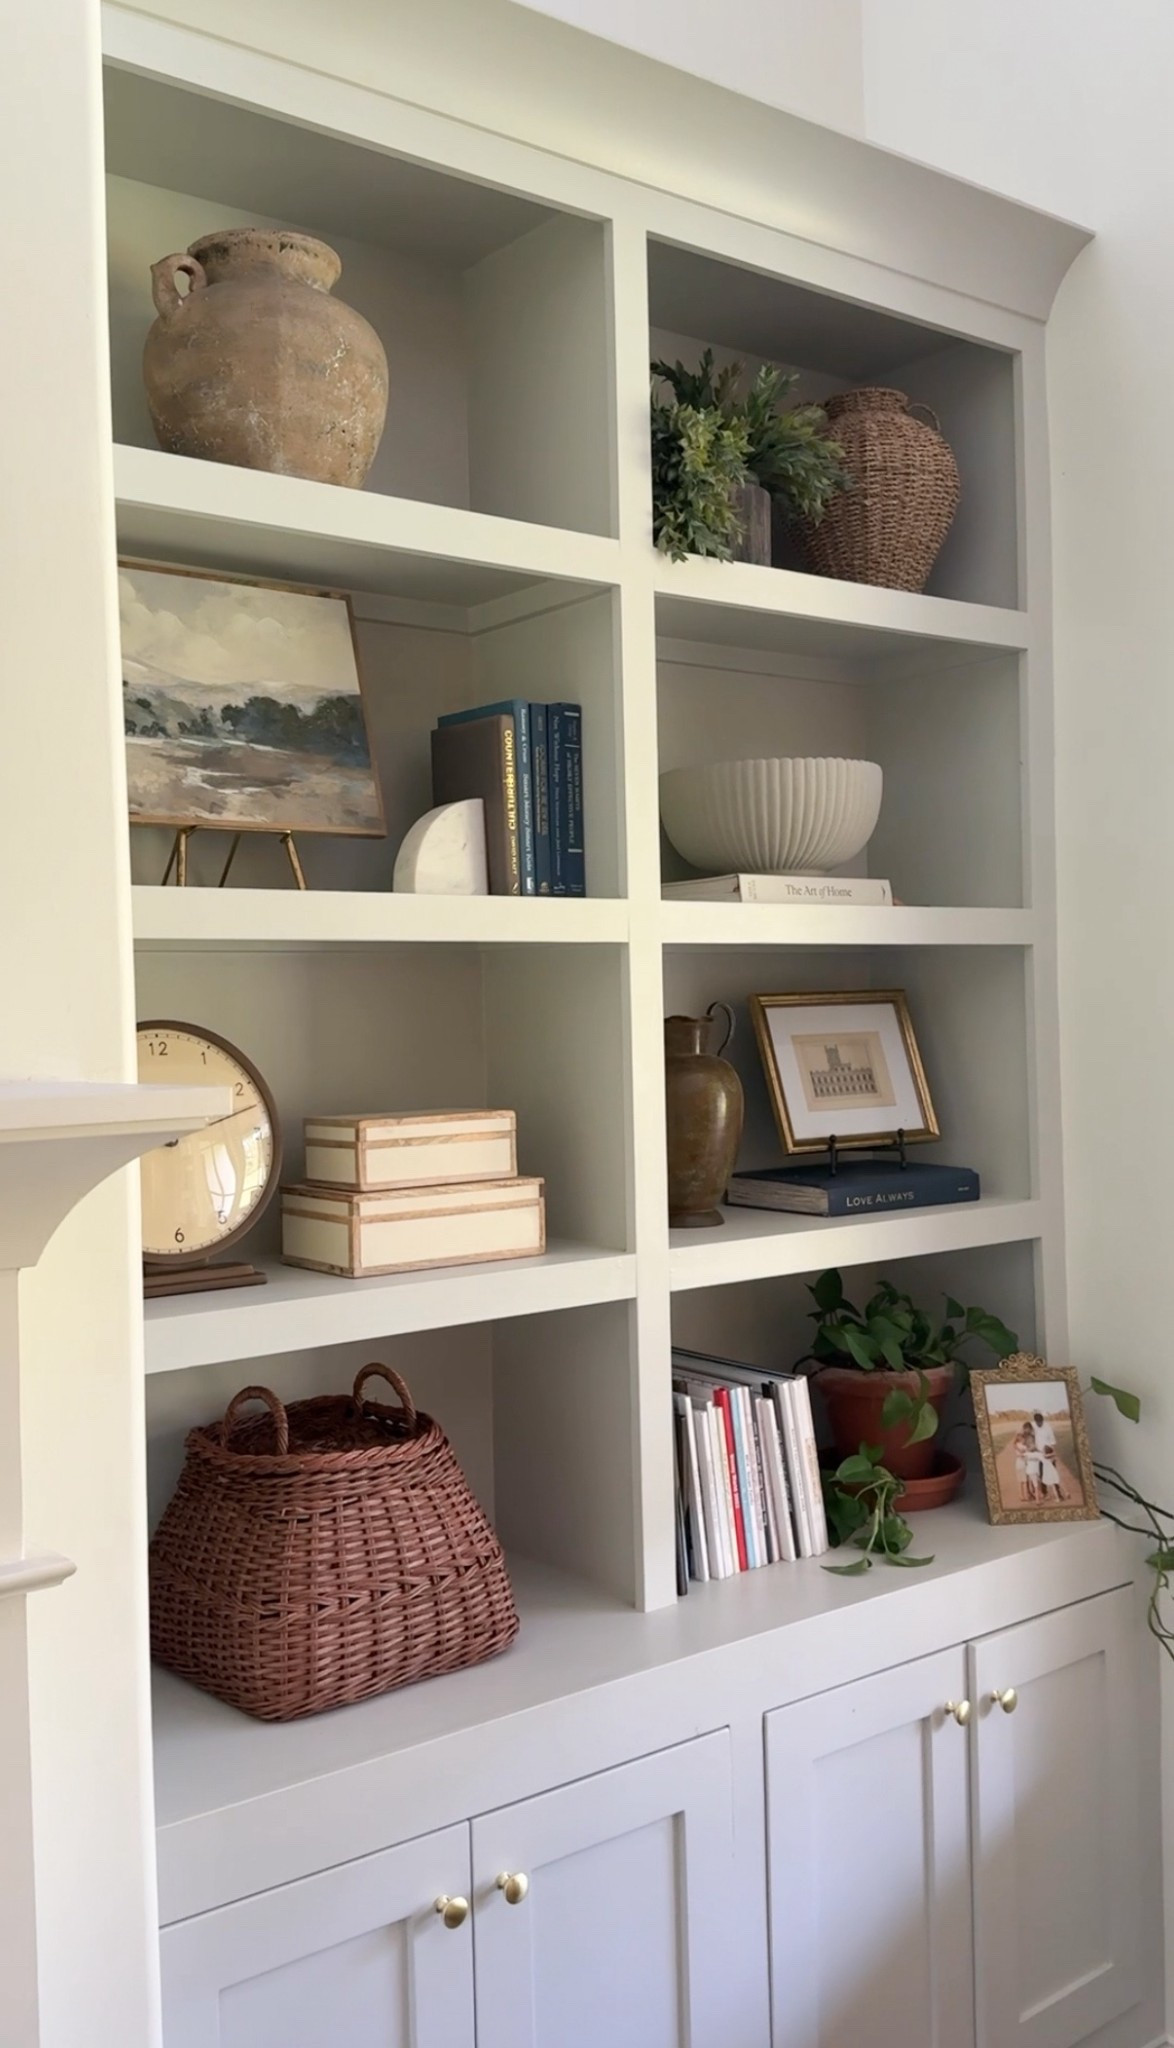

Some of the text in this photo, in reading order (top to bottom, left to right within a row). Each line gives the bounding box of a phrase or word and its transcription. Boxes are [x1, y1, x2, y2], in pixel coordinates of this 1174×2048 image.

[784, 884, 802, 896] The
[803, 885, 818, 896] Art
[827, 886, 853, 897] Home
[148, 1041, 169, 1057] 12
[235, 1082, 244, 1097] 2
[846, 1191, 915, 1208] LOVE ALWAYS
[217, 1210, 228, 1225] 5
[174, 1227, 185, 1244] 6
